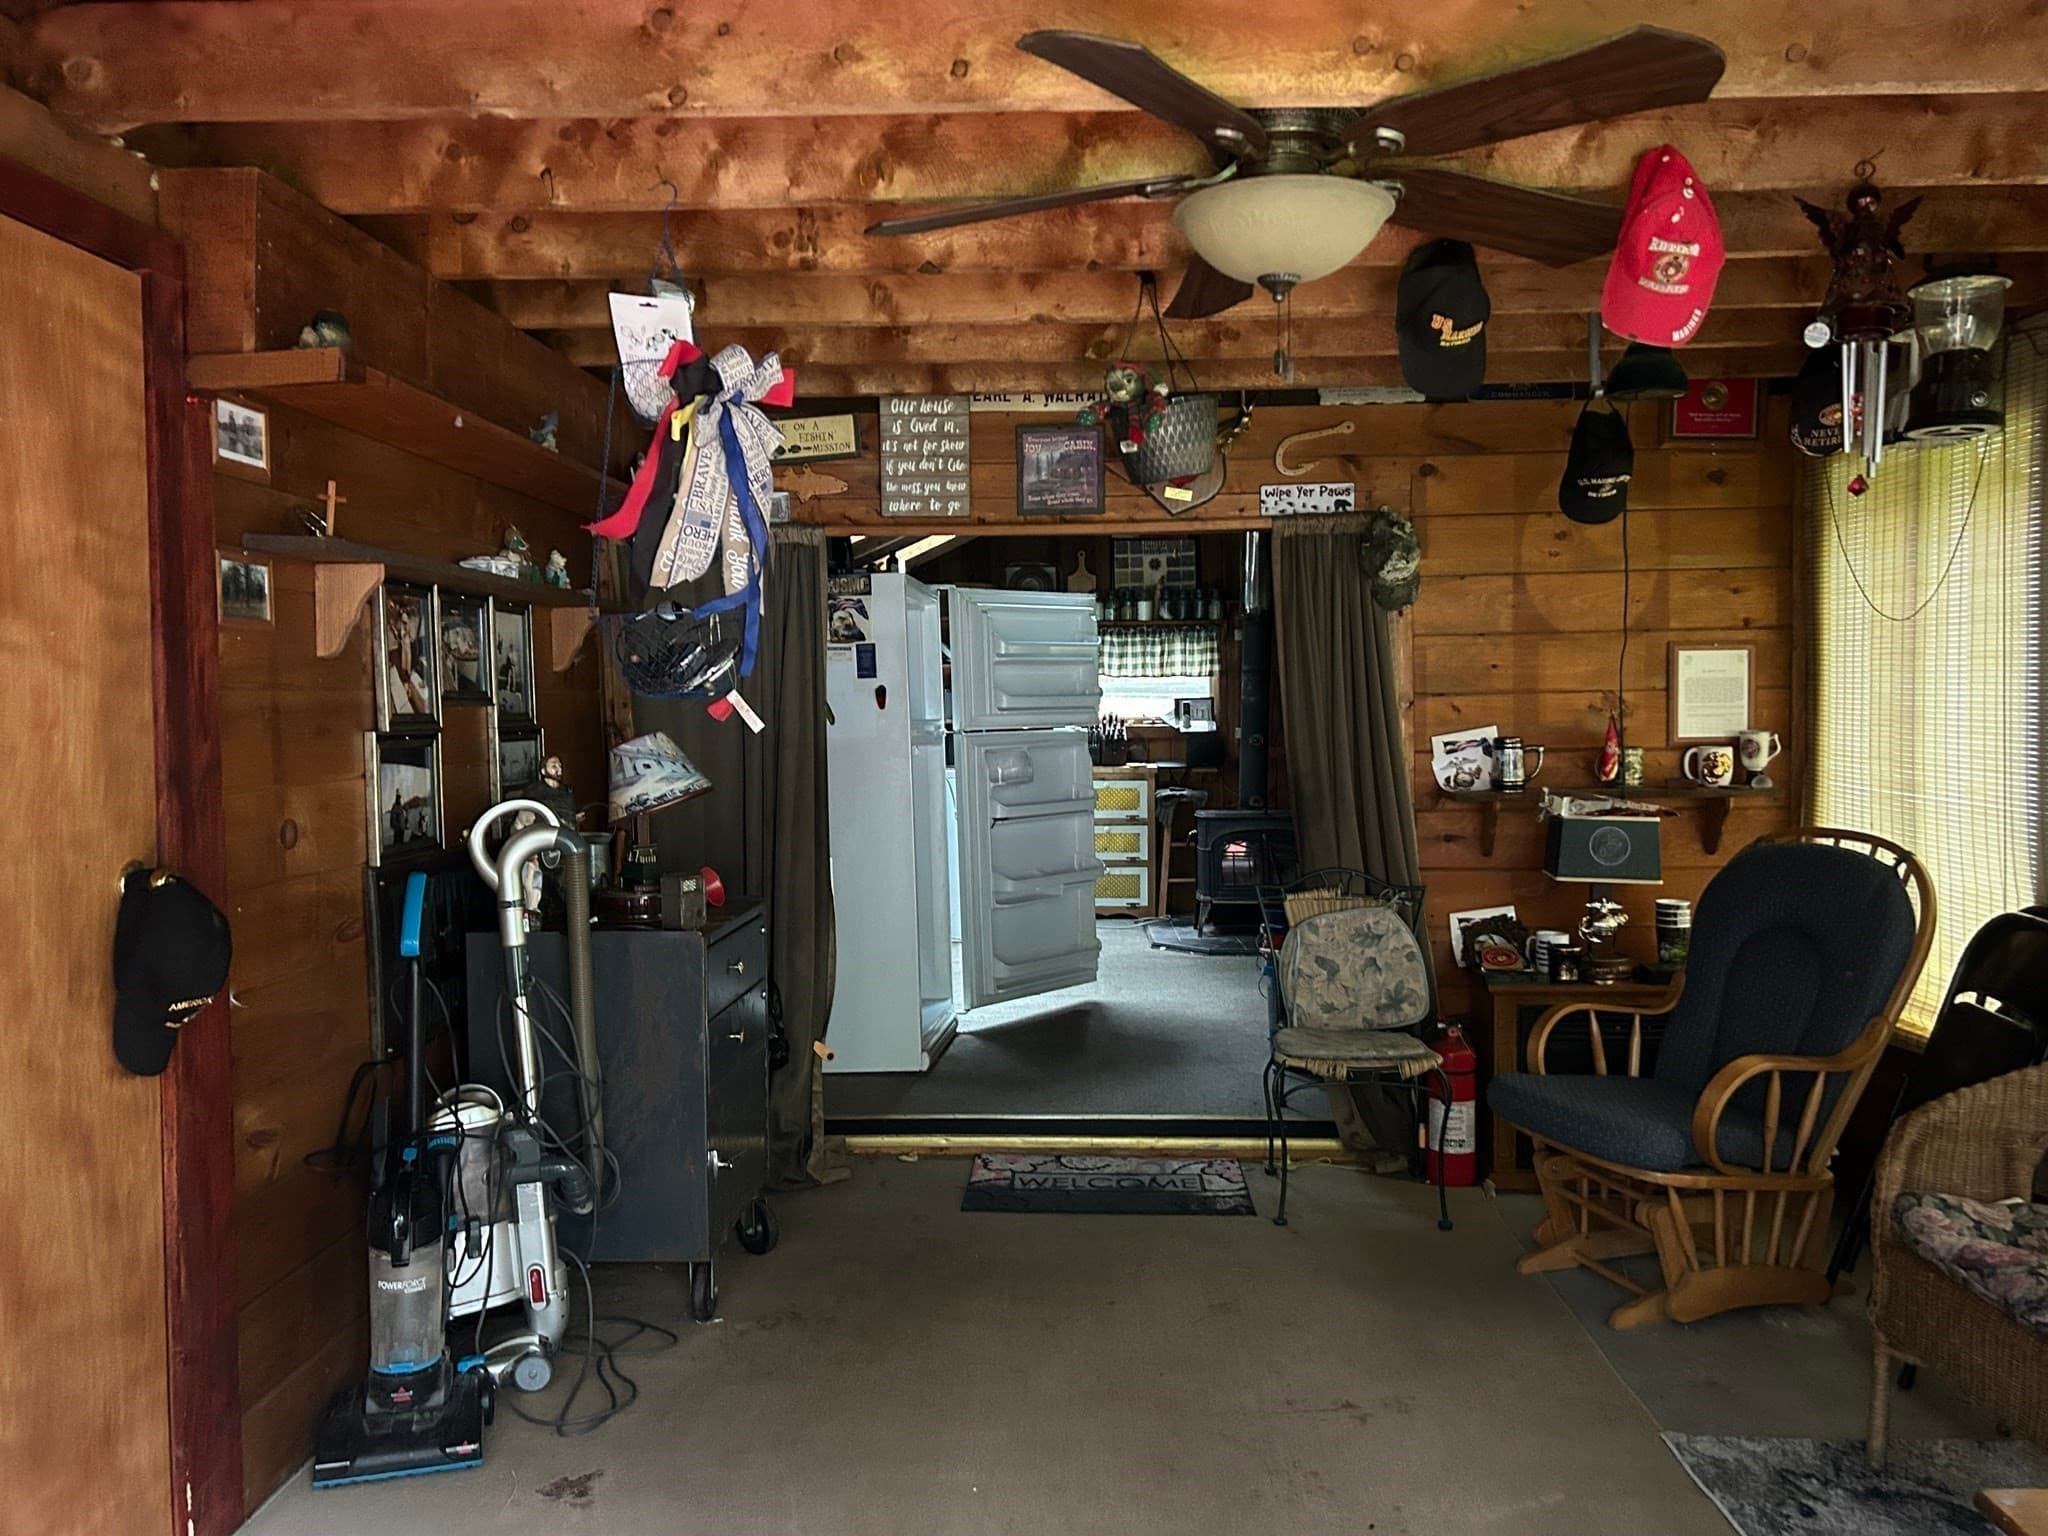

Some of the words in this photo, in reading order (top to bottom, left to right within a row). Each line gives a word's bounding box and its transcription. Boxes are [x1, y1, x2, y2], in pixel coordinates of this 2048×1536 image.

[891, 398, 917, 415] Our
[919, 398, 954, 415] house
[793, 423, 806, 432] ON
[812, 420, 820, 431] A
[892, 419, 903, 435] is
[910, 417, 938, 433] lived
[812, 441, 851, 453] MISSION
[903, 439, 918, 453] not
[923, 439, 938, 456] for
[940, 439, 965, 453] show
[1023, 442, 1042, 453] JOY
[692, 449, 714, 500] BRAVE
[897, 459, 916, 476] you
[947, 457, 967, 472] like
[886, 480, 899, 492] the
[923, 481, 941, 496] you
[946, 480, 967, 493] know
[1296, 485, 1315, 498] Yer
[1319, 485, 1351, 497] Paws
[888, 498, 922, 512] where
[929, 497, 942, 511] to
[947, 500, 961, 516] go
[683, 525, 717, 541] HERO
[726, 549, 749, 590] You
[1018, 1176, 1198, 1190] WELCOME
